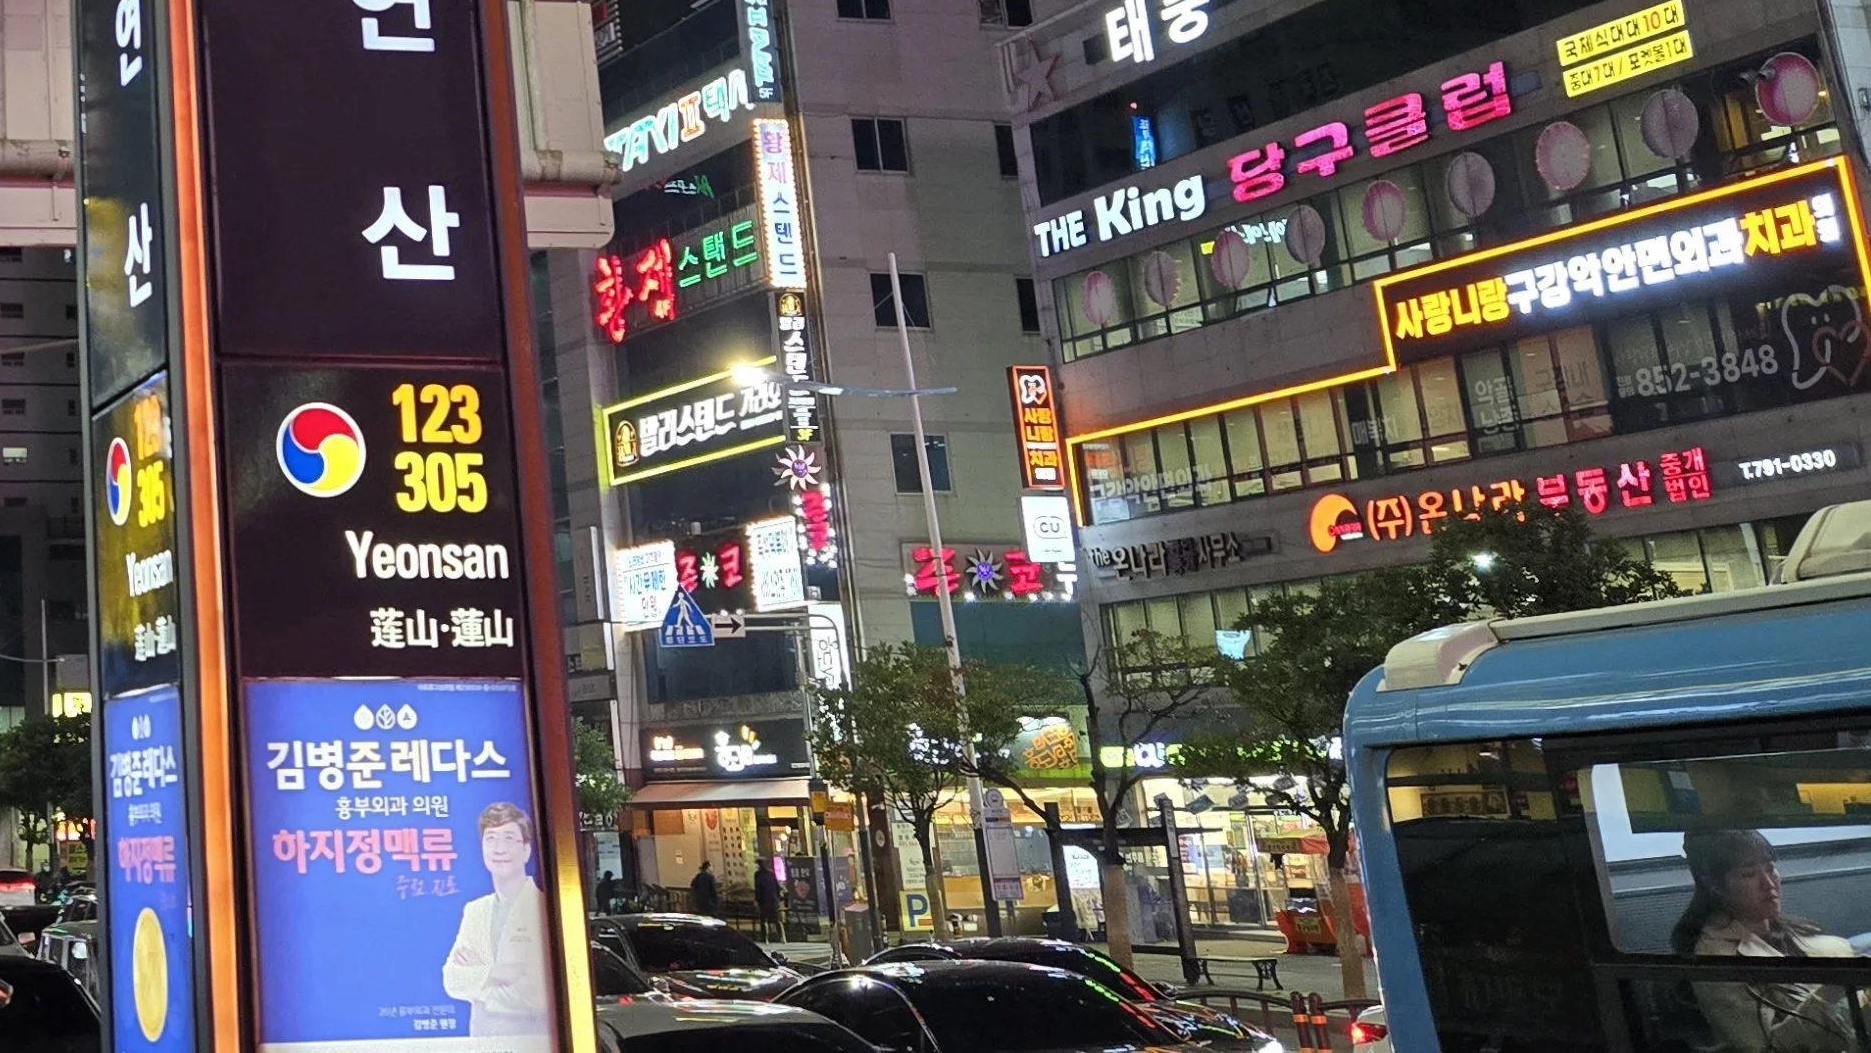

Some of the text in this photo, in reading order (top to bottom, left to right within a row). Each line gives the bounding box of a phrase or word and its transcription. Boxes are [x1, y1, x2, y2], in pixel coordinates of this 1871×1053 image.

[1033, 209, 1087, 255] THE
[1093, 174, 1207, 243] King
[1225, 59, 1515, 205] 당구클럽
[1635, 343, 1779, 397] 852-3848
[391, 382, 484, 447] 123
[1028, 448, 1058, 468] 치과
[1659, 447, 1706, 476] 중개
[1738, 448, 1837, 481] T.791-0330
[136, 459, 166, 528] 305
[393, 450, 489, 515] 305
[1535, 460, 1653, 516] 부동산
[1663, 476, 1712, 504] 법인
[1039, 521, 1061, 534] CU
[125, 549, 175, 598] Yeonsan
[344, 530, 510, 581] Yeonsan
[334, 795, 450, 821] 흉부외과 의원
[272, 827, 458, 875] 하지정맥류
[906, 893, 930, 929] P
